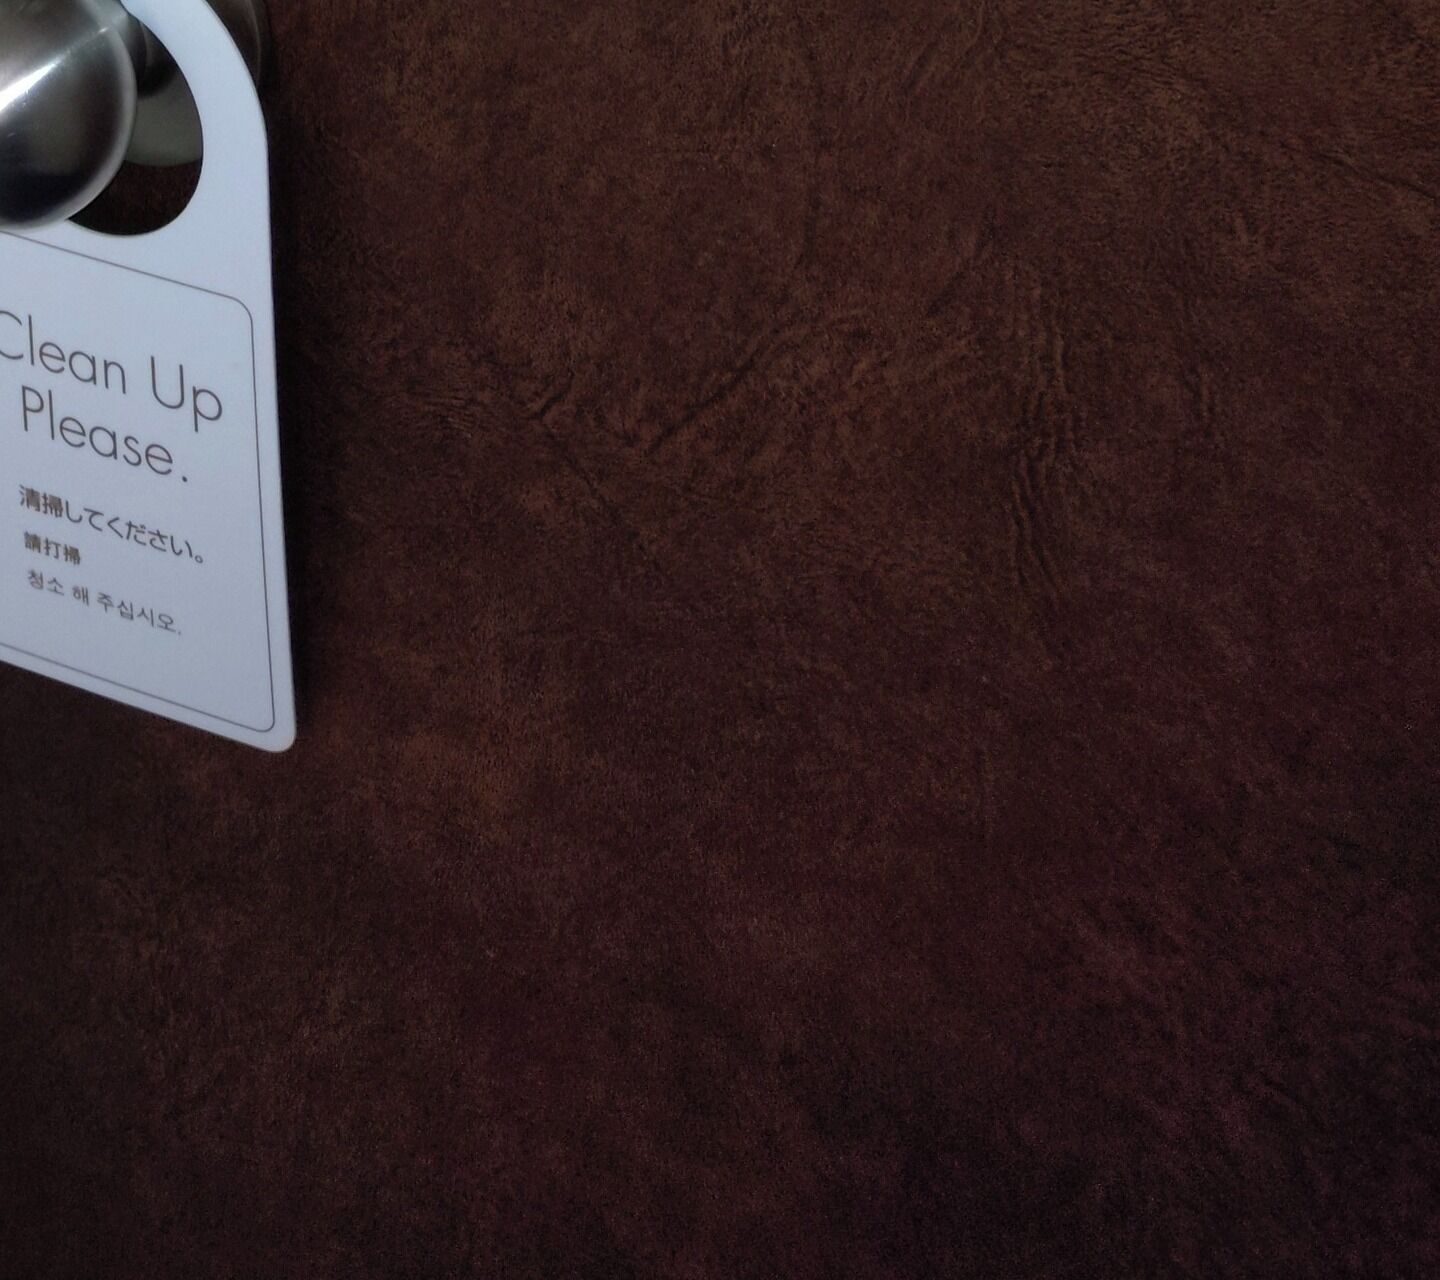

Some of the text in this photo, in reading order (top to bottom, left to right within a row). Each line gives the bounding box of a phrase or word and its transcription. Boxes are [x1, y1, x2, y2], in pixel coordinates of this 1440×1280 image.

[150, 355, 223, 433] Up
[21, 385, 188, 483] Please.
[19, 484, 204, 564] 清掃してください。
[28, 569, 182, 636] 청소 해 주십시오.
